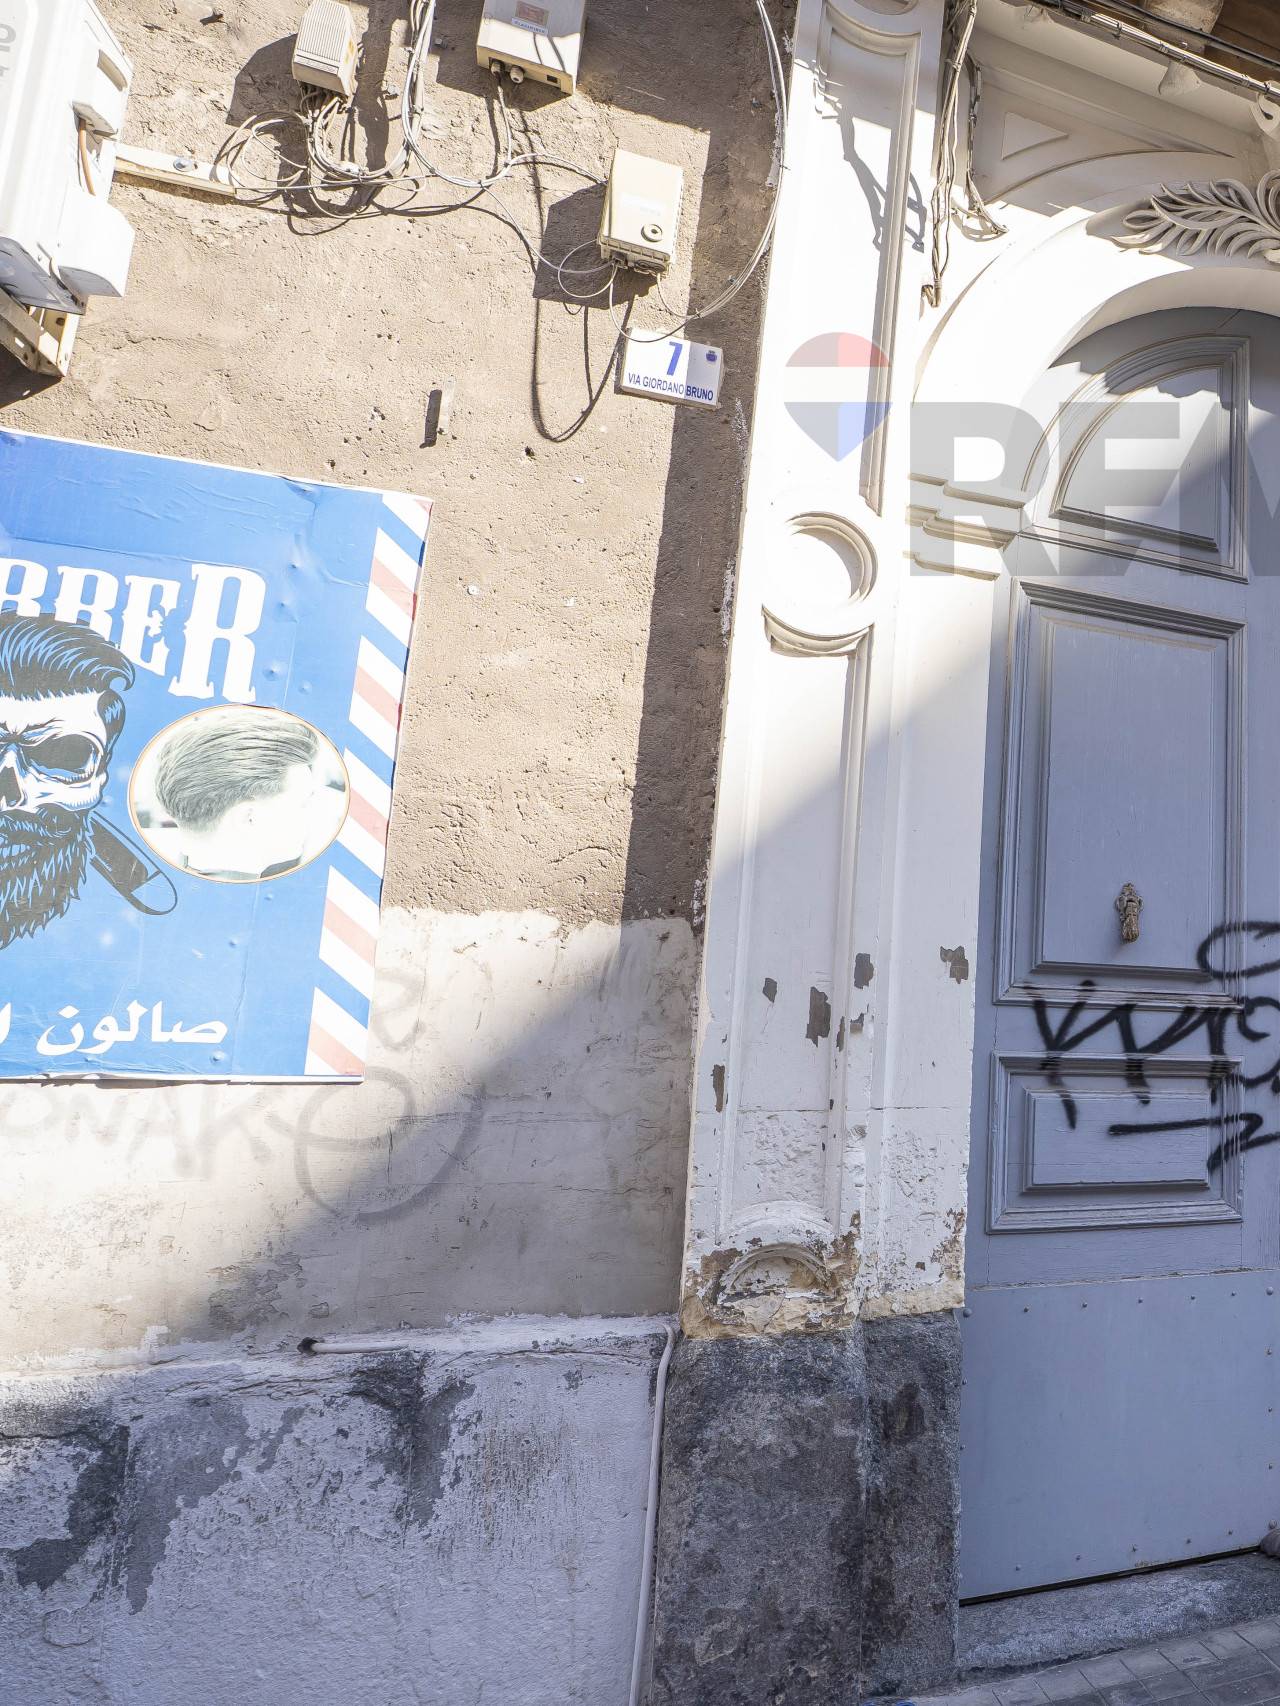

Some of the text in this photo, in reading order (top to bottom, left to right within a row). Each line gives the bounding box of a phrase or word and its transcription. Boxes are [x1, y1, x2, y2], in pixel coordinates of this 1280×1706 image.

[666, 341, 684, 377] 7
[628, 372, 714, 401] VIA GIORDANO BRUNO
[36, 999, 228, 1056] صالون
